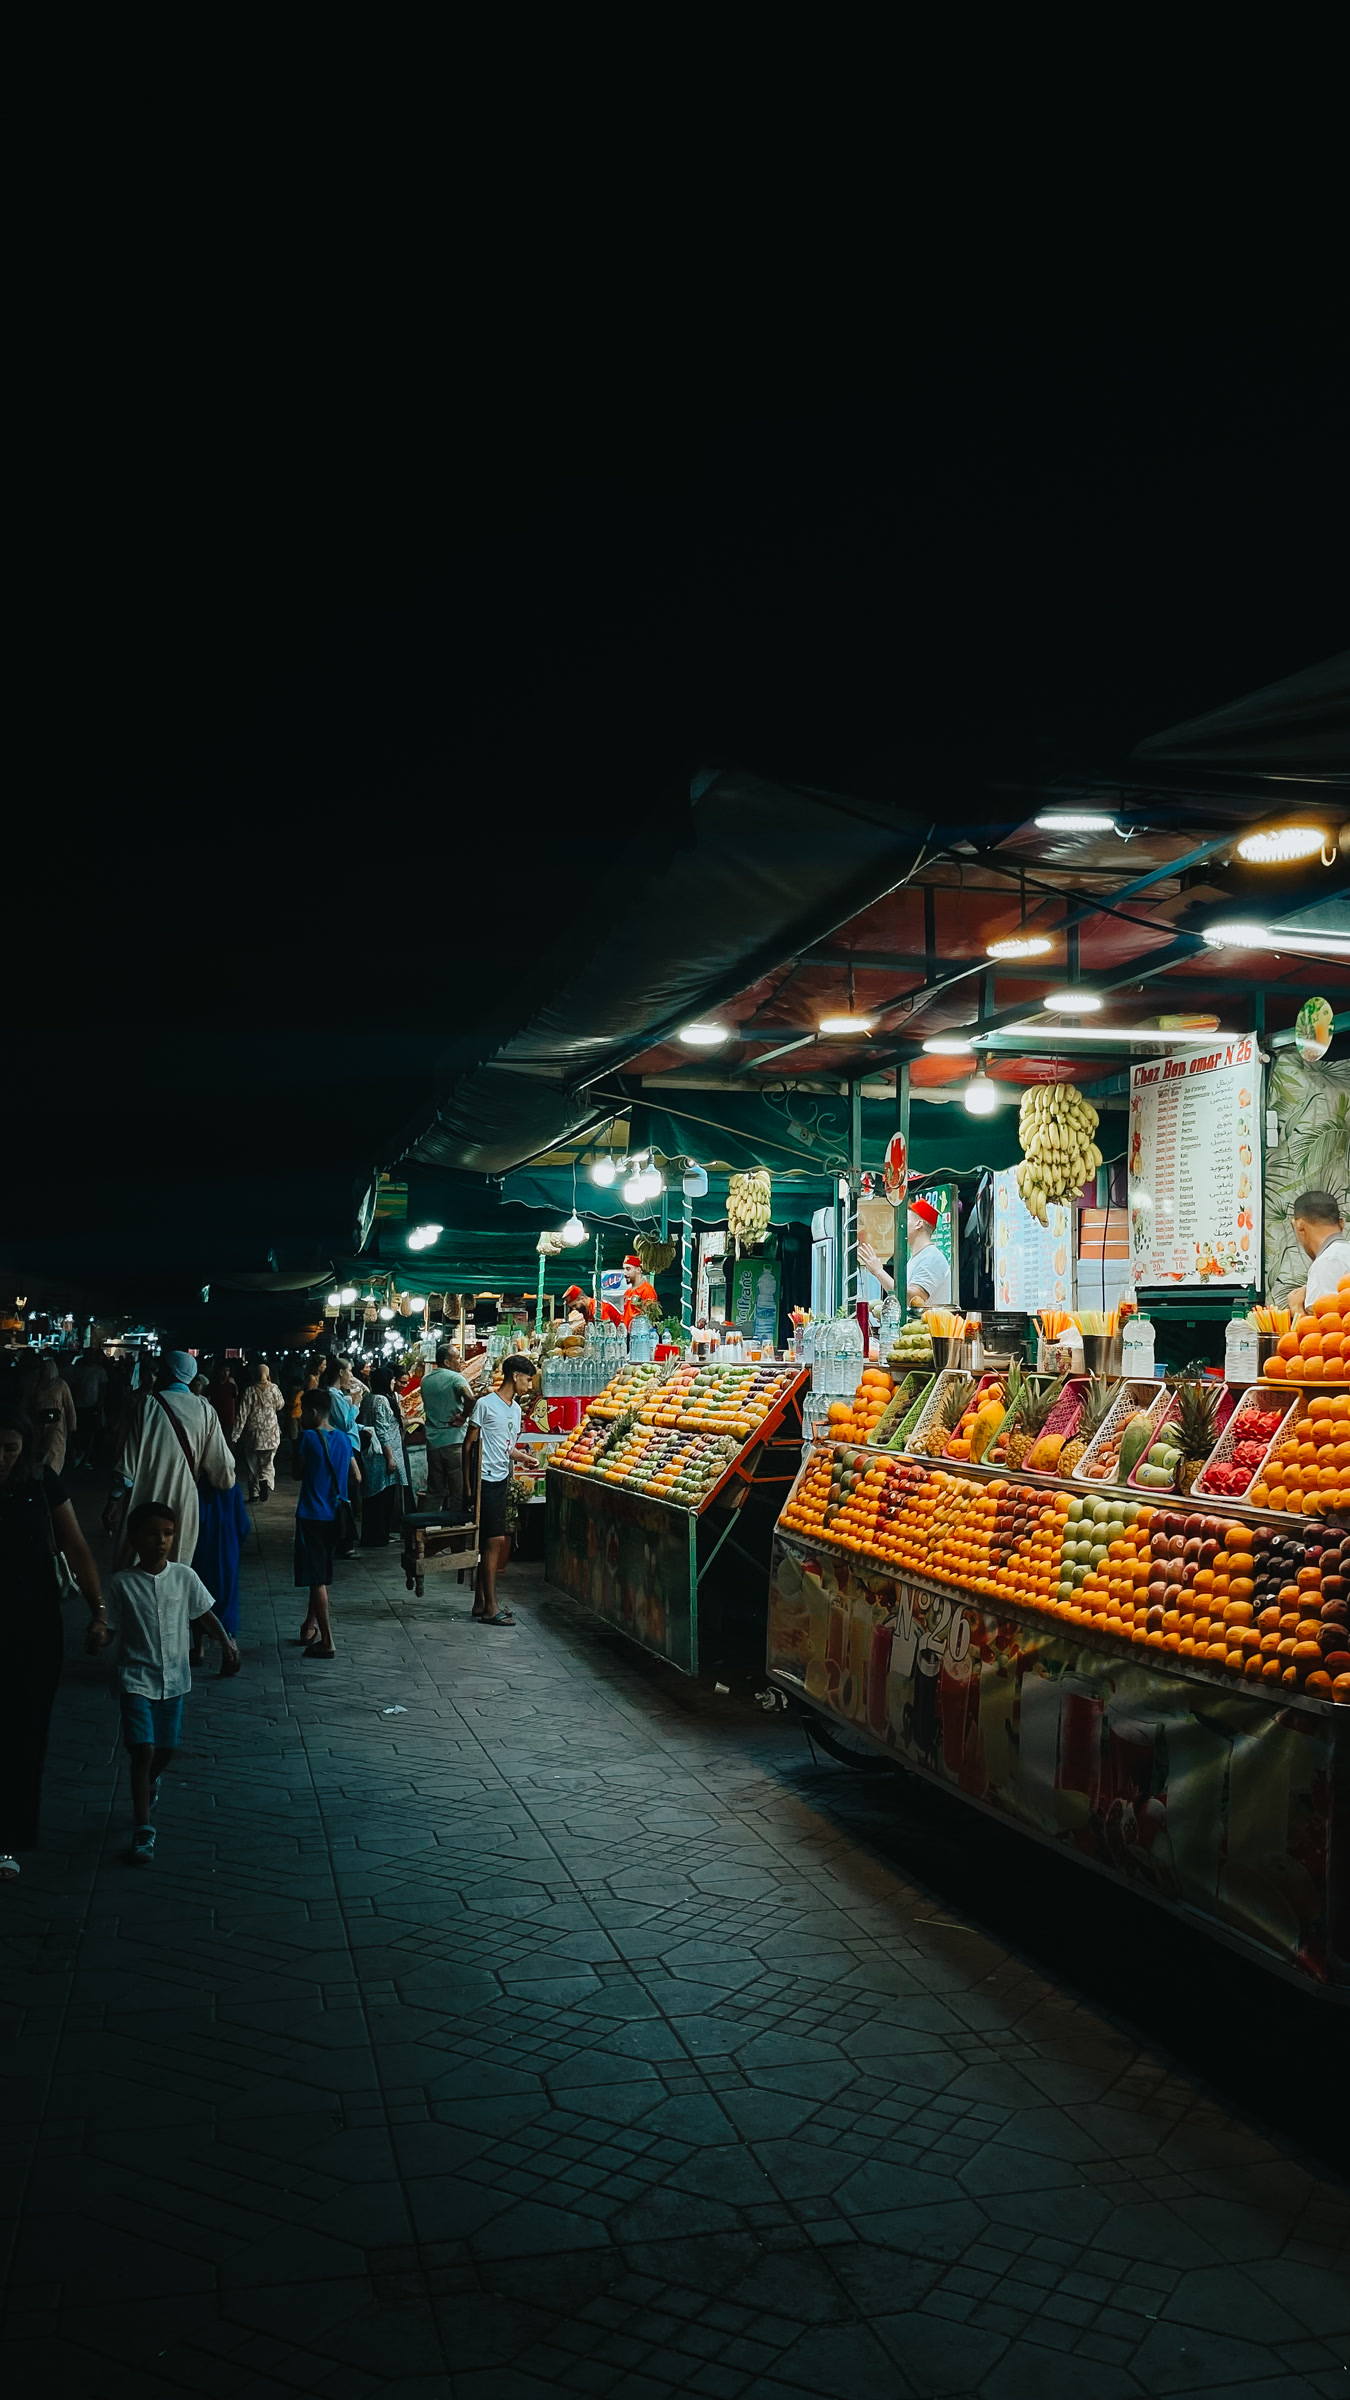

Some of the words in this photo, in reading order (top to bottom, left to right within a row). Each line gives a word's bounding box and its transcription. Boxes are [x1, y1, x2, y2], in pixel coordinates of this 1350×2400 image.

[1134, 1066, 1160, 1086] Chez
[1189, 1052, 1222, 1074] omar
[1224, 1044, 1235, 1066] N
[1236, 1040, 1252, 1063] 26
